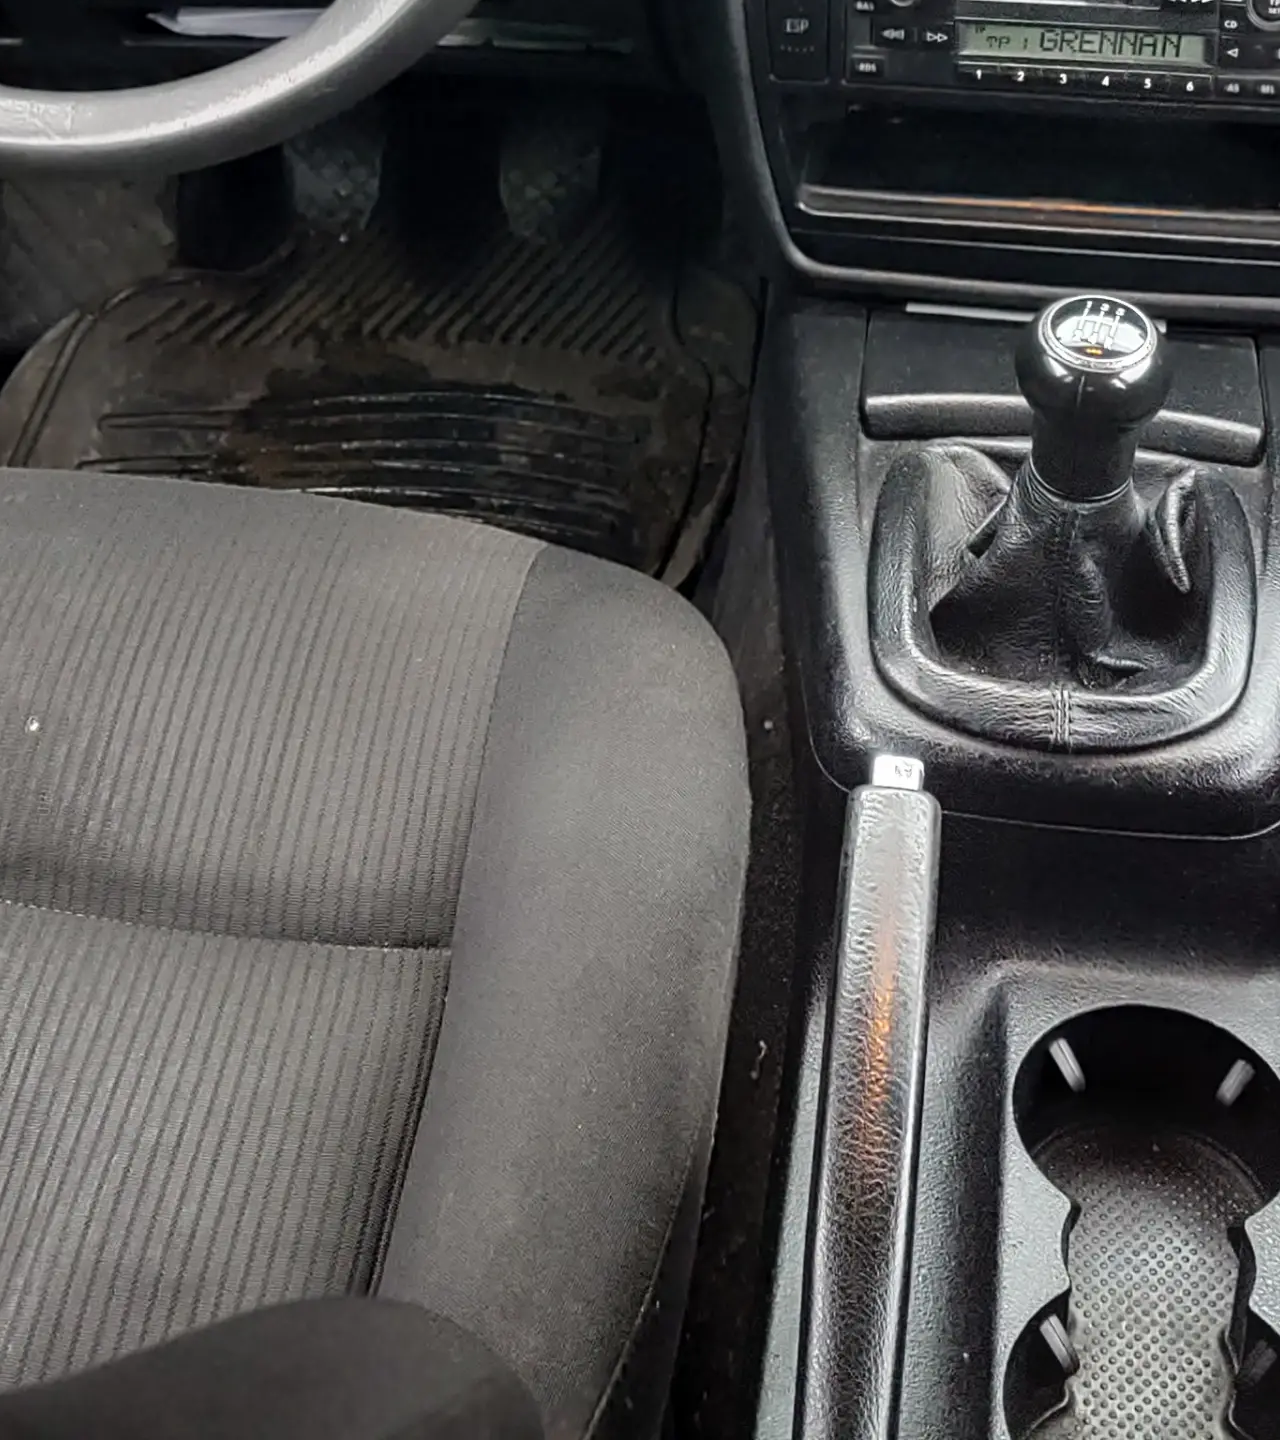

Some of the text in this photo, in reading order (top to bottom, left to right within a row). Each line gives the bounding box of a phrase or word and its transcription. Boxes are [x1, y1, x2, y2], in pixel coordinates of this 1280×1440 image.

[1040, 28, 1182, 57] GRENNAN
[975, 68, 1194, 92] 1 2 3 4 5 6
